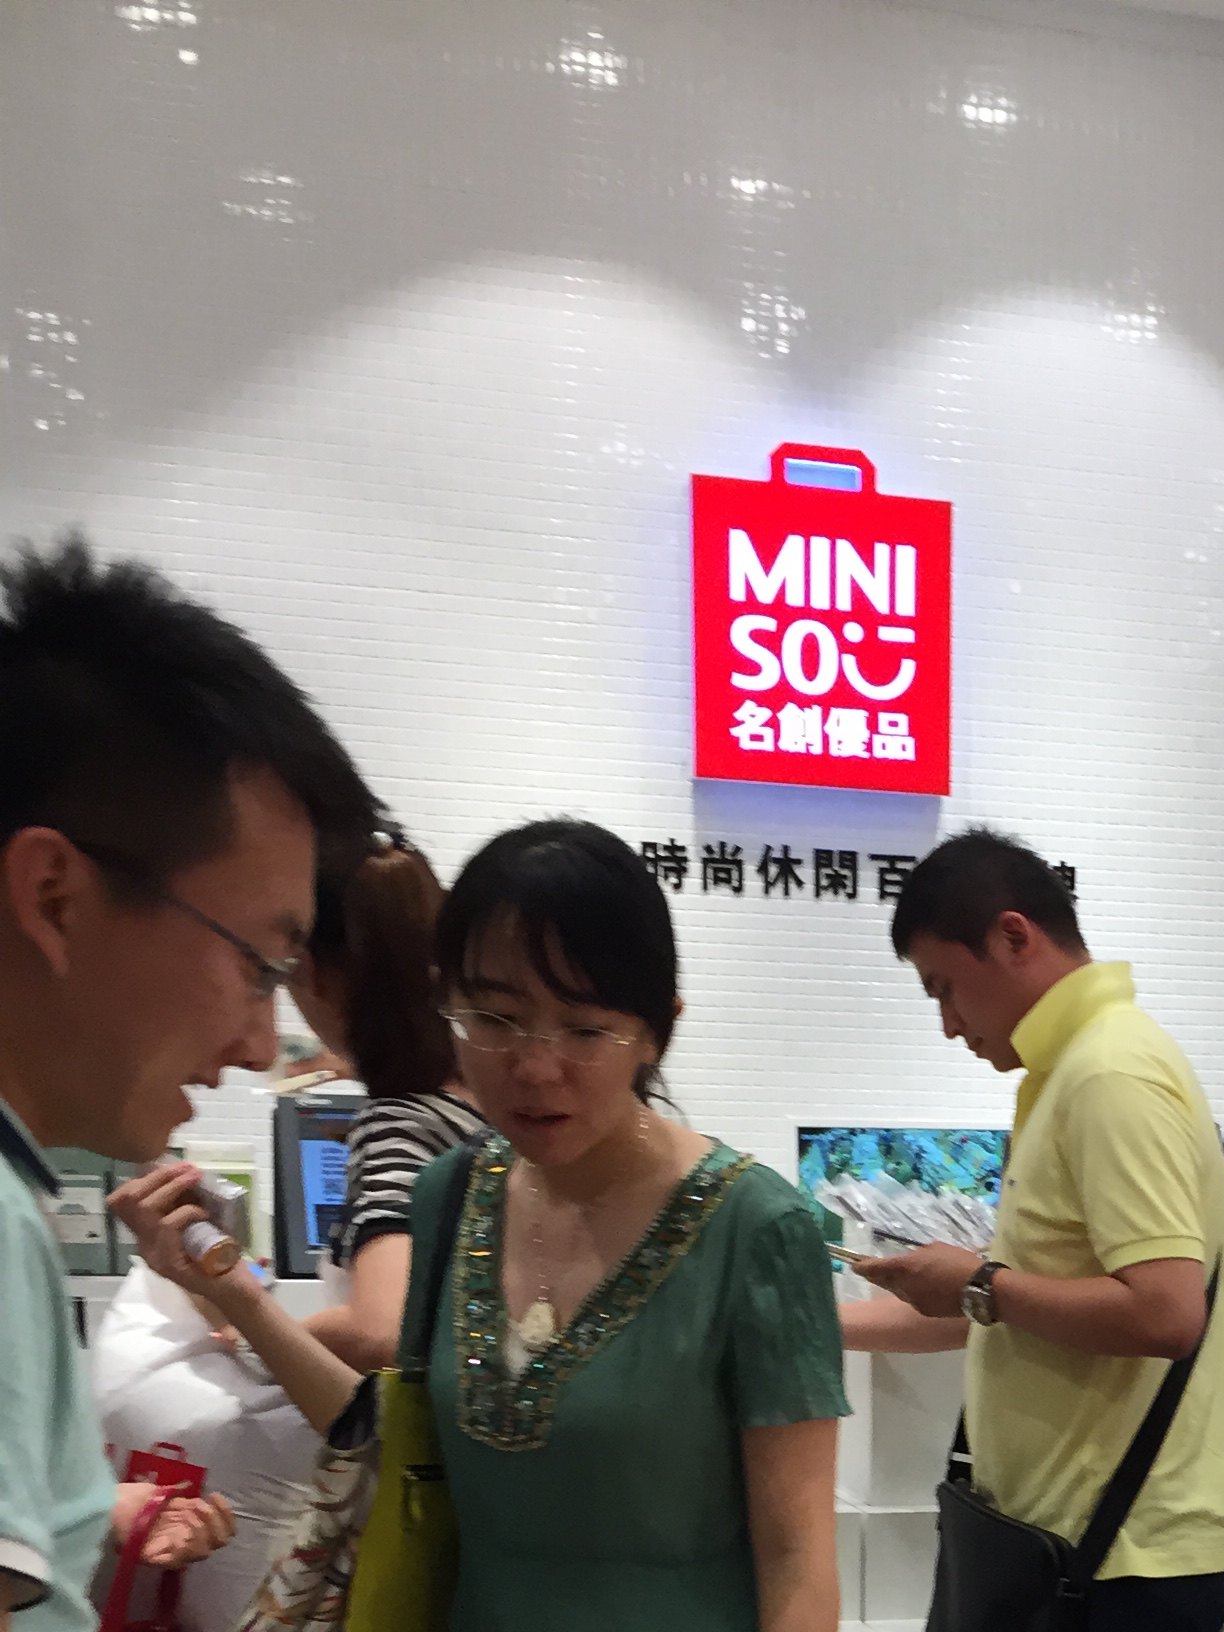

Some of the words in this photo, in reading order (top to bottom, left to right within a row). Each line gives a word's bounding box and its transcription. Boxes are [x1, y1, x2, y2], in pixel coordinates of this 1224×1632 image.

[728, 528, 917, 616] MINI
[729, 700, 916, 761] 名創優品
